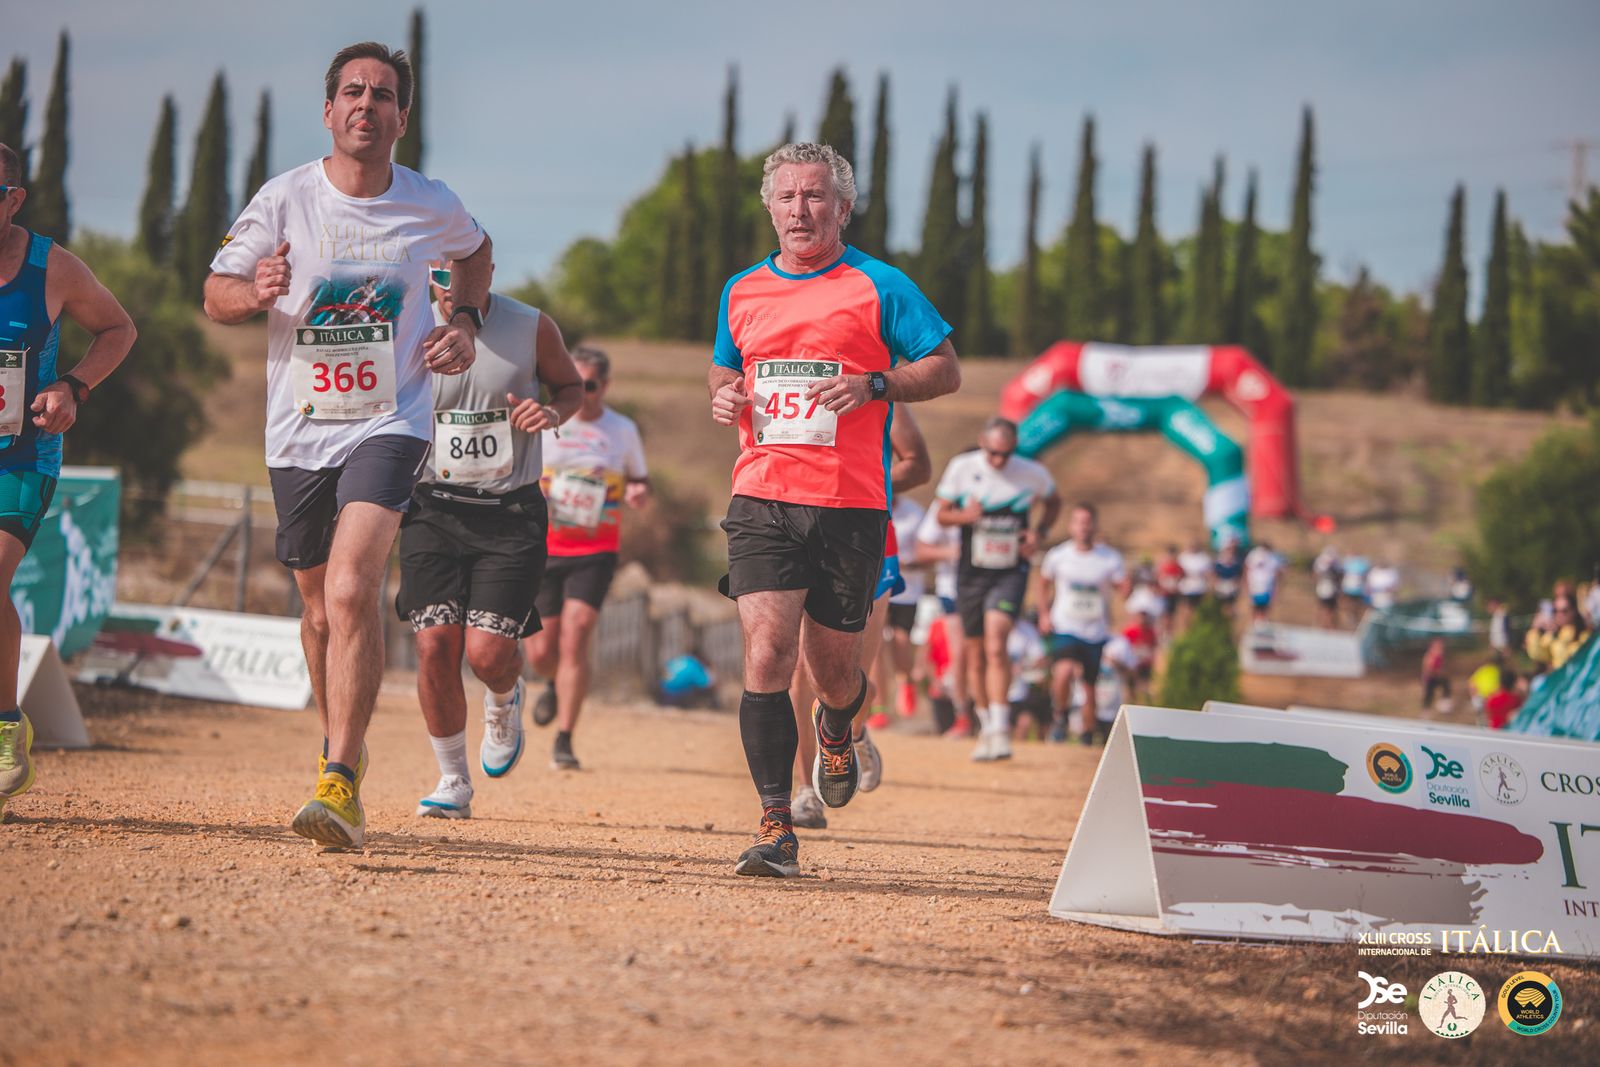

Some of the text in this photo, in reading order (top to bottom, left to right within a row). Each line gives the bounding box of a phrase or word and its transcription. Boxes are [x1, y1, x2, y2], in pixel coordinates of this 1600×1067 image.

[320, 330, 365, 342] ITÁLICA
[313, 360, 377, 393] 366
[773, 362, 816, 375] ITÁLICA
[764, 392, 820, 419] 457
[450, 435, 498, 459] 840
[1426, 781, 1469, 795] Diputación
[1429, 792, 1471, 808] Sevilla
